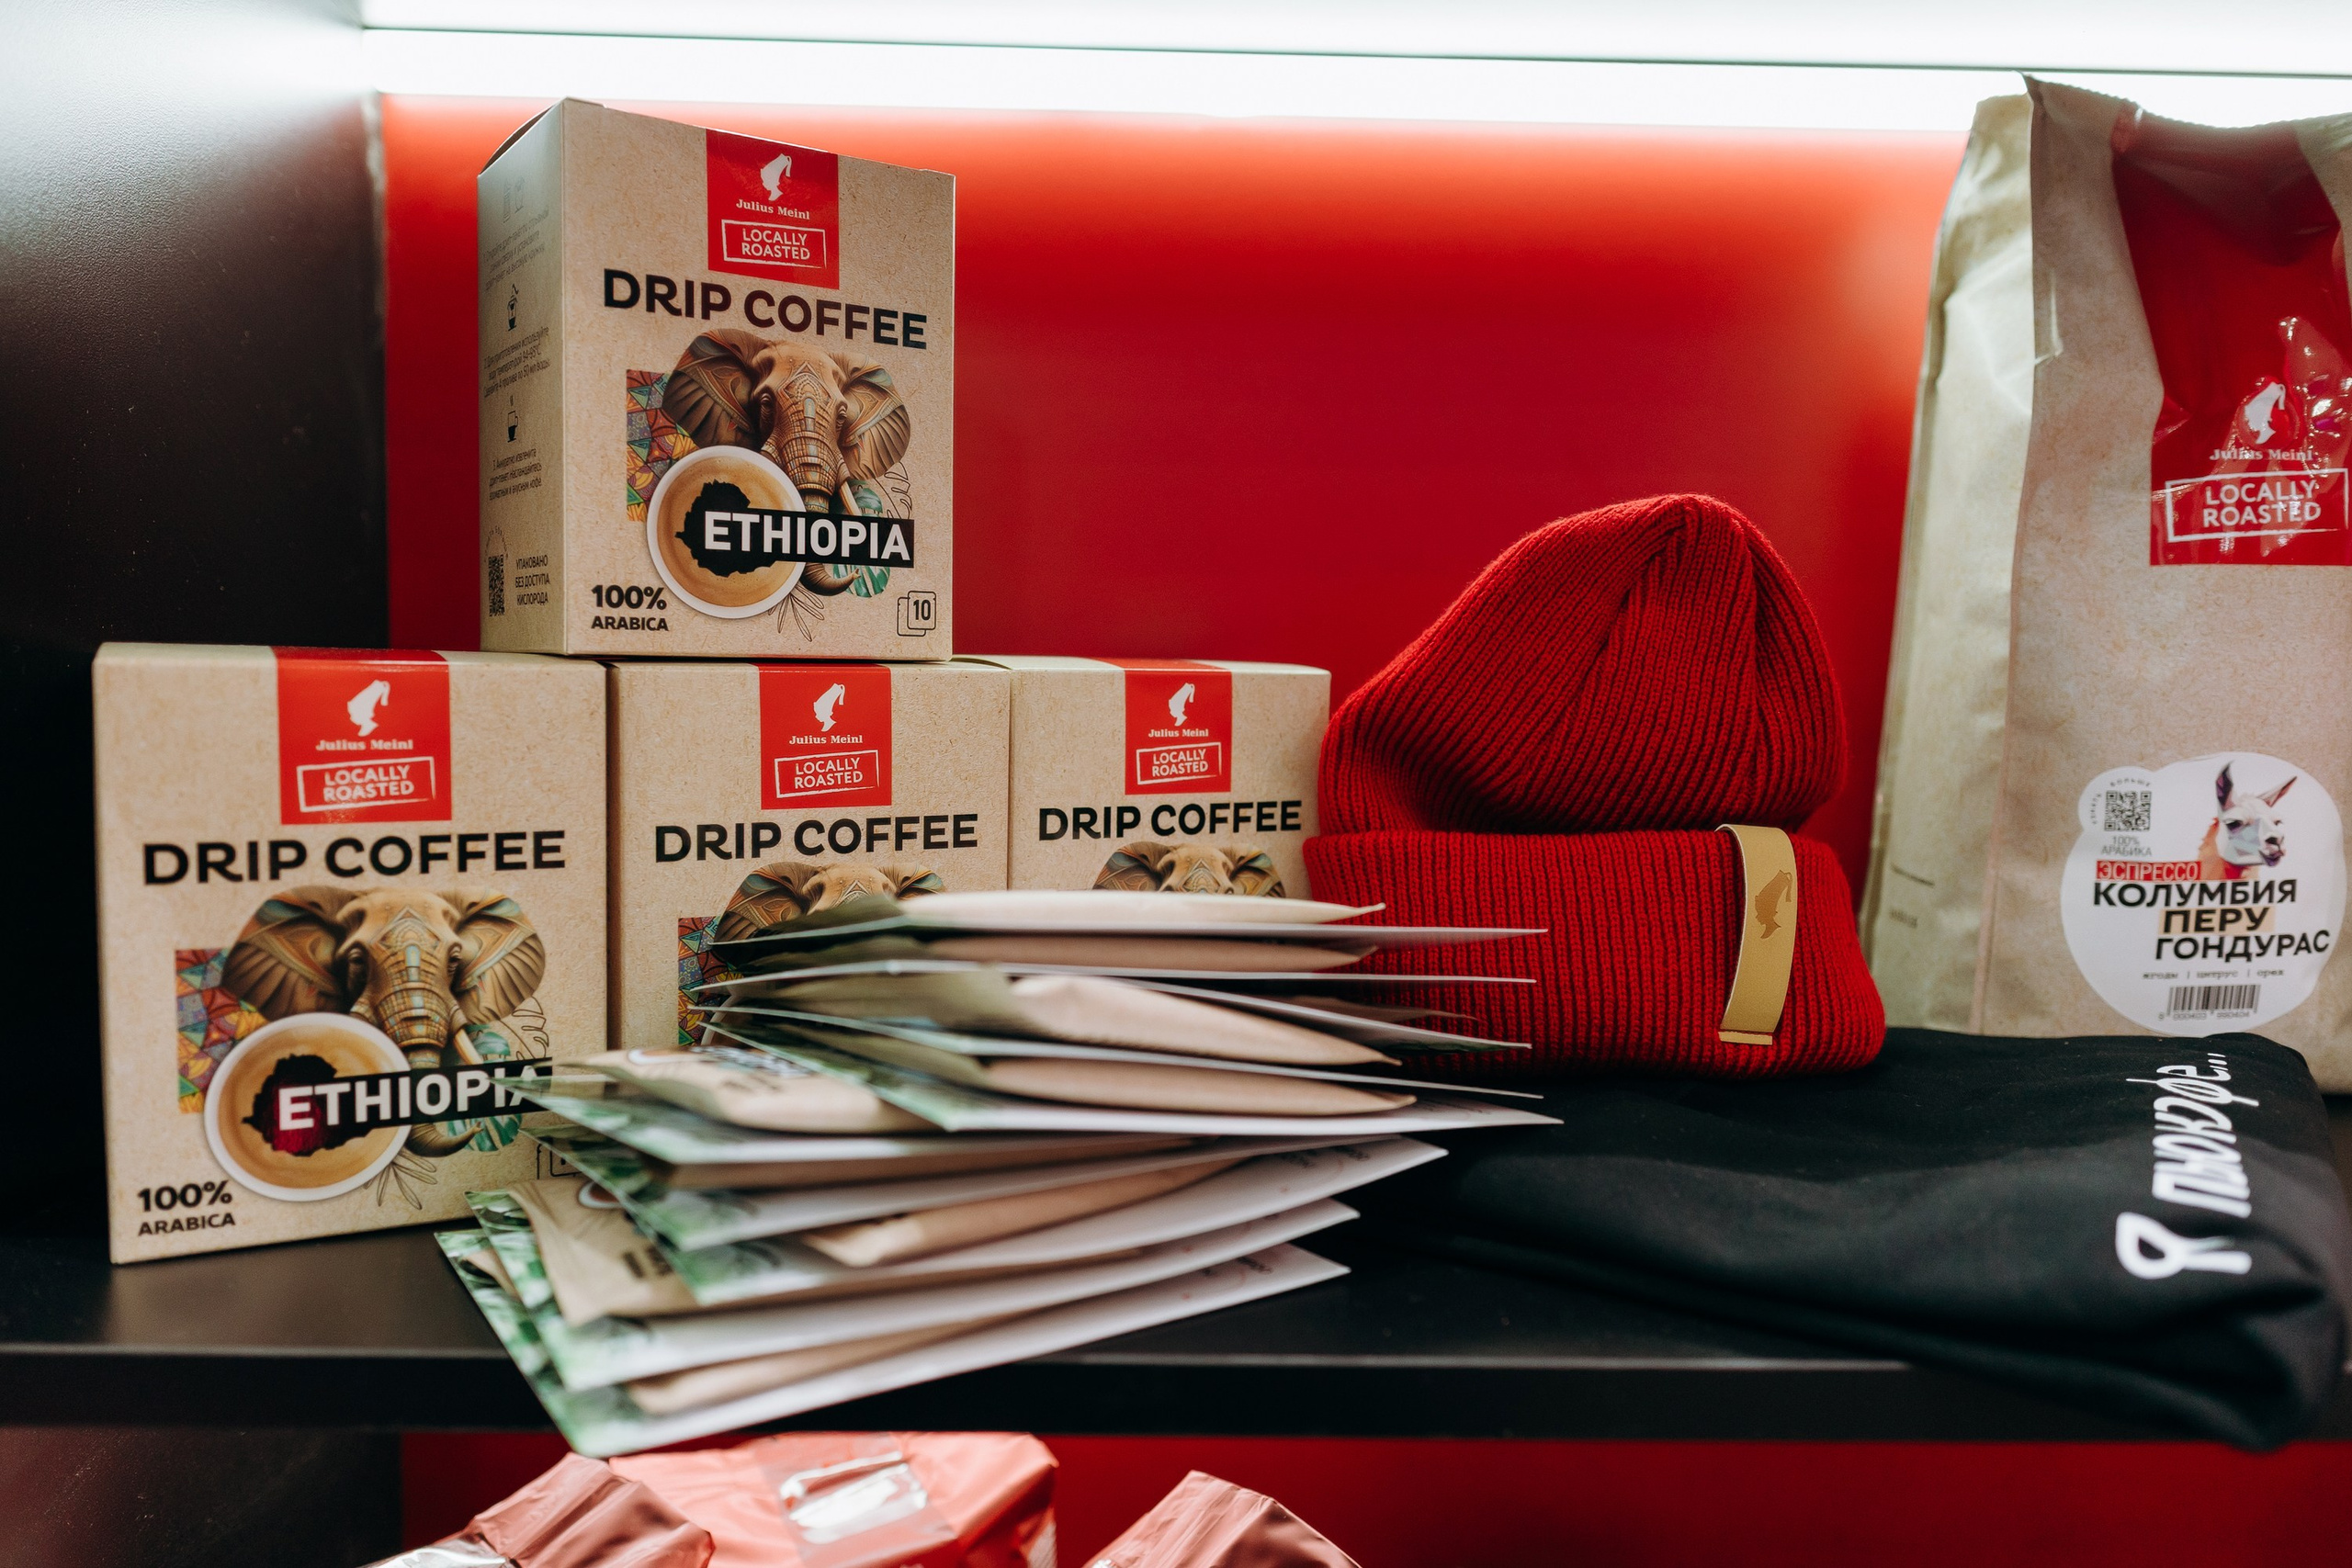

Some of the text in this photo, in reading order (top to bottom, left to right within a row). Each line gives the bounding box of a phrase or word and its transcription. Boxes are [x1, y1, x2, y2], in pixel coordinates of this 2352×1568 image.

[736, 199, 810, 220] Julius Meinl
[742, 228, 808, 246] LOCALLY
[741, 243, 810, 261] ROASTED
[604, 268, 927, 350] DRIP COFFEE
[2210, 449, 2313, 461] Julius Meinl
[2206, 479, 2316, 505] LOCALLY
[2203, 502, 2321, 527] ROASTED
[705, 511, 910, 561] ETHIOPIA
[515, 554, 548, 570] УПАКОВАНО
[515, 573, 550, 589] БЕЗ ДОСТУПА
[517, 592, 548, 606] КИСЛОРОДА
[592, 584, 667, 610] 100%
[913, 599, 931, 621] 10
[591, 615, 669, 631] ARABICA
[789, 735, 863, 745] Julius Meinl
[1148, 728, 1209, 738] Julius Meinl
[315, 738, 413, 751] Julius Meinl
[795, 757, 860, 775] LOCALLY
[1153, 749, 1206, 764] LOCALLY
[324, 764, 411, 786] LOCALLY
[1152, 761, 1208, 777] ROASTED
[794, 771, 863, 789] ROASTED
[323, 779, 414, 803] ROASTED
[1039, 800, 1302, 840] DRIP COFFEE
[656, 814, 978, 863] DRIP COFFEE
[143, 830, 566, 886] DRIP COFFEE
[2101, 846, 2152, 856] АРАБИКА
[2099, 862, 2199, 881] ЭСПРЕССО
[2094, 879, 2297, 907] КОЛУМБИЯ
[2163, 908, 2269, 933] ПЕРУ
[2155, 930, 2330, 962] ГОНДУРАС
[138, 1180, 232, 1212] 100%
[138, 1213, 235, 1236] ARABICA
[2115, 1212, 2252, 1280] Я
